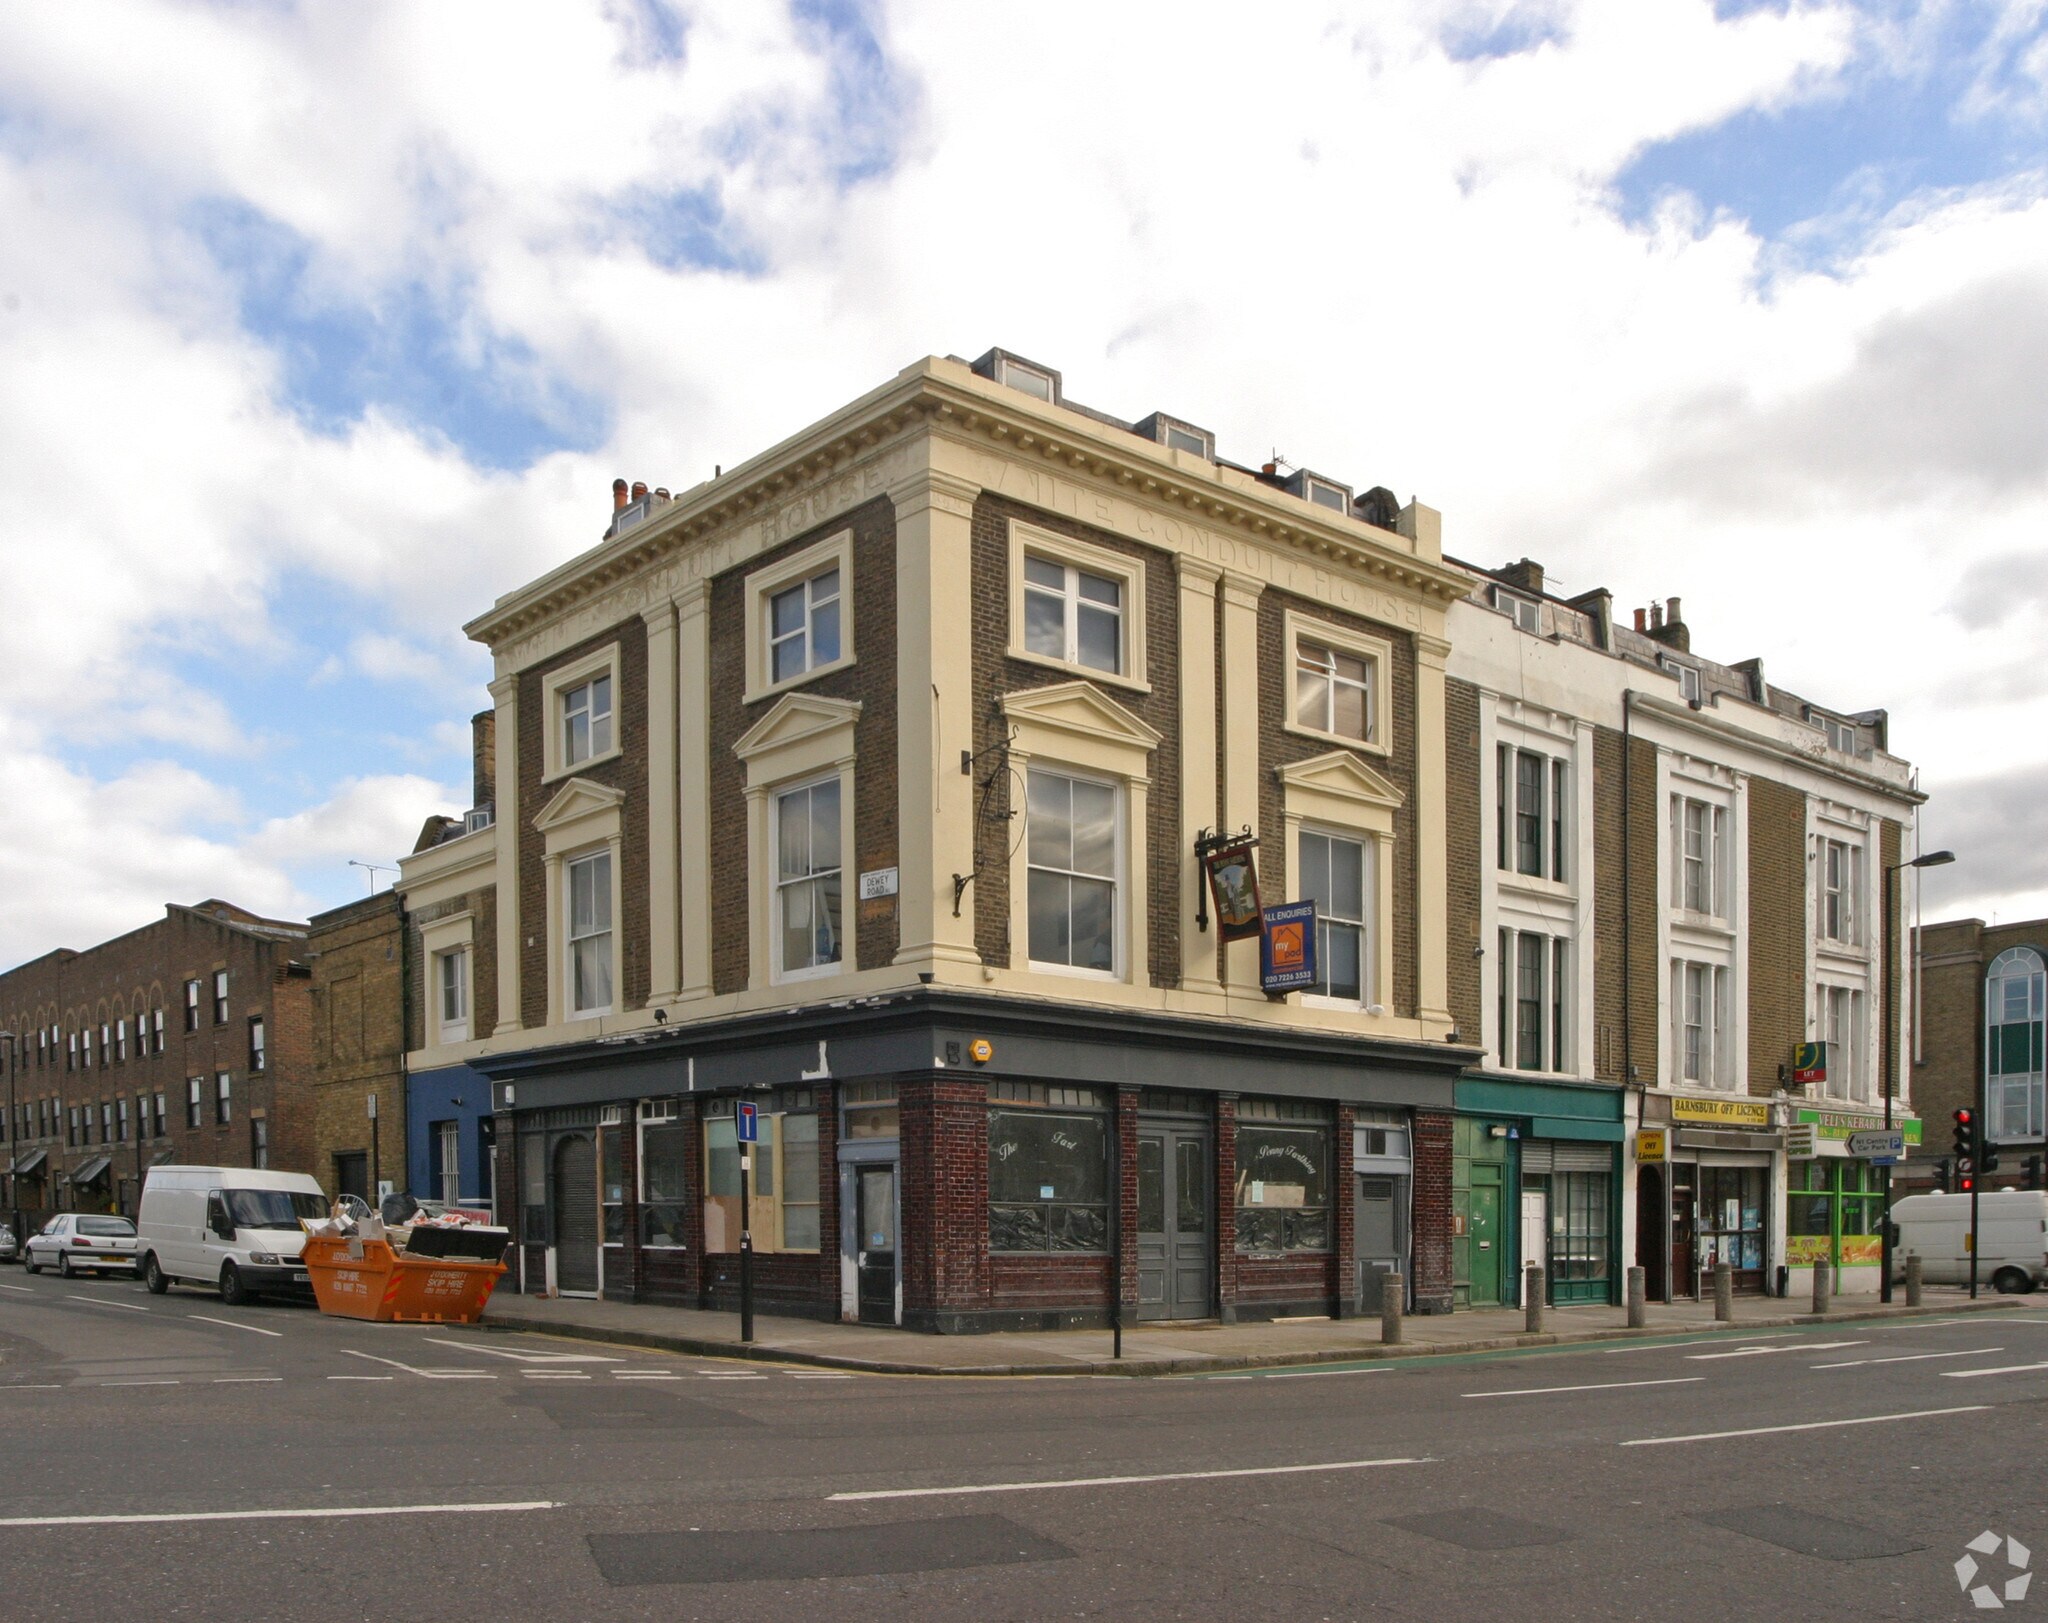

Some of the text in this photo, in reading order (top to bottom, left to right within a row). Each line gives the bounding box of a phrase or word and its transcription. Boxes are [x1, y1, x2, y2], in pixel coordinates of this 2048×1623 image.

[867, 875, 888, 886] DEWEY
[867, 886, 885, 896] ROAD
[1264, 907, 1312, 922] ALL ENQUIRIES
[1275, 942, 1289, 951] my
[1285, 950, 1302, 959] pad
[1265, 970, 1312, 983] 020 7226 3533
[1675, 1099, 1765, 1117] BARNSBURY OFF LICENCE
[1819, 1113, 1846, 1127] VELI'S
[1847, 1116, 1875, 1129] KEBAB
[999, 1142, 1018, 1161] The
[1871, 1143, 1887, 1151] Park
[1259, 1145, 1317, 1175] Penny Farthing
[1637, 1152, 1664, 1160] Licence
[427, 1278, 465, 1288] SKIP HIRE
